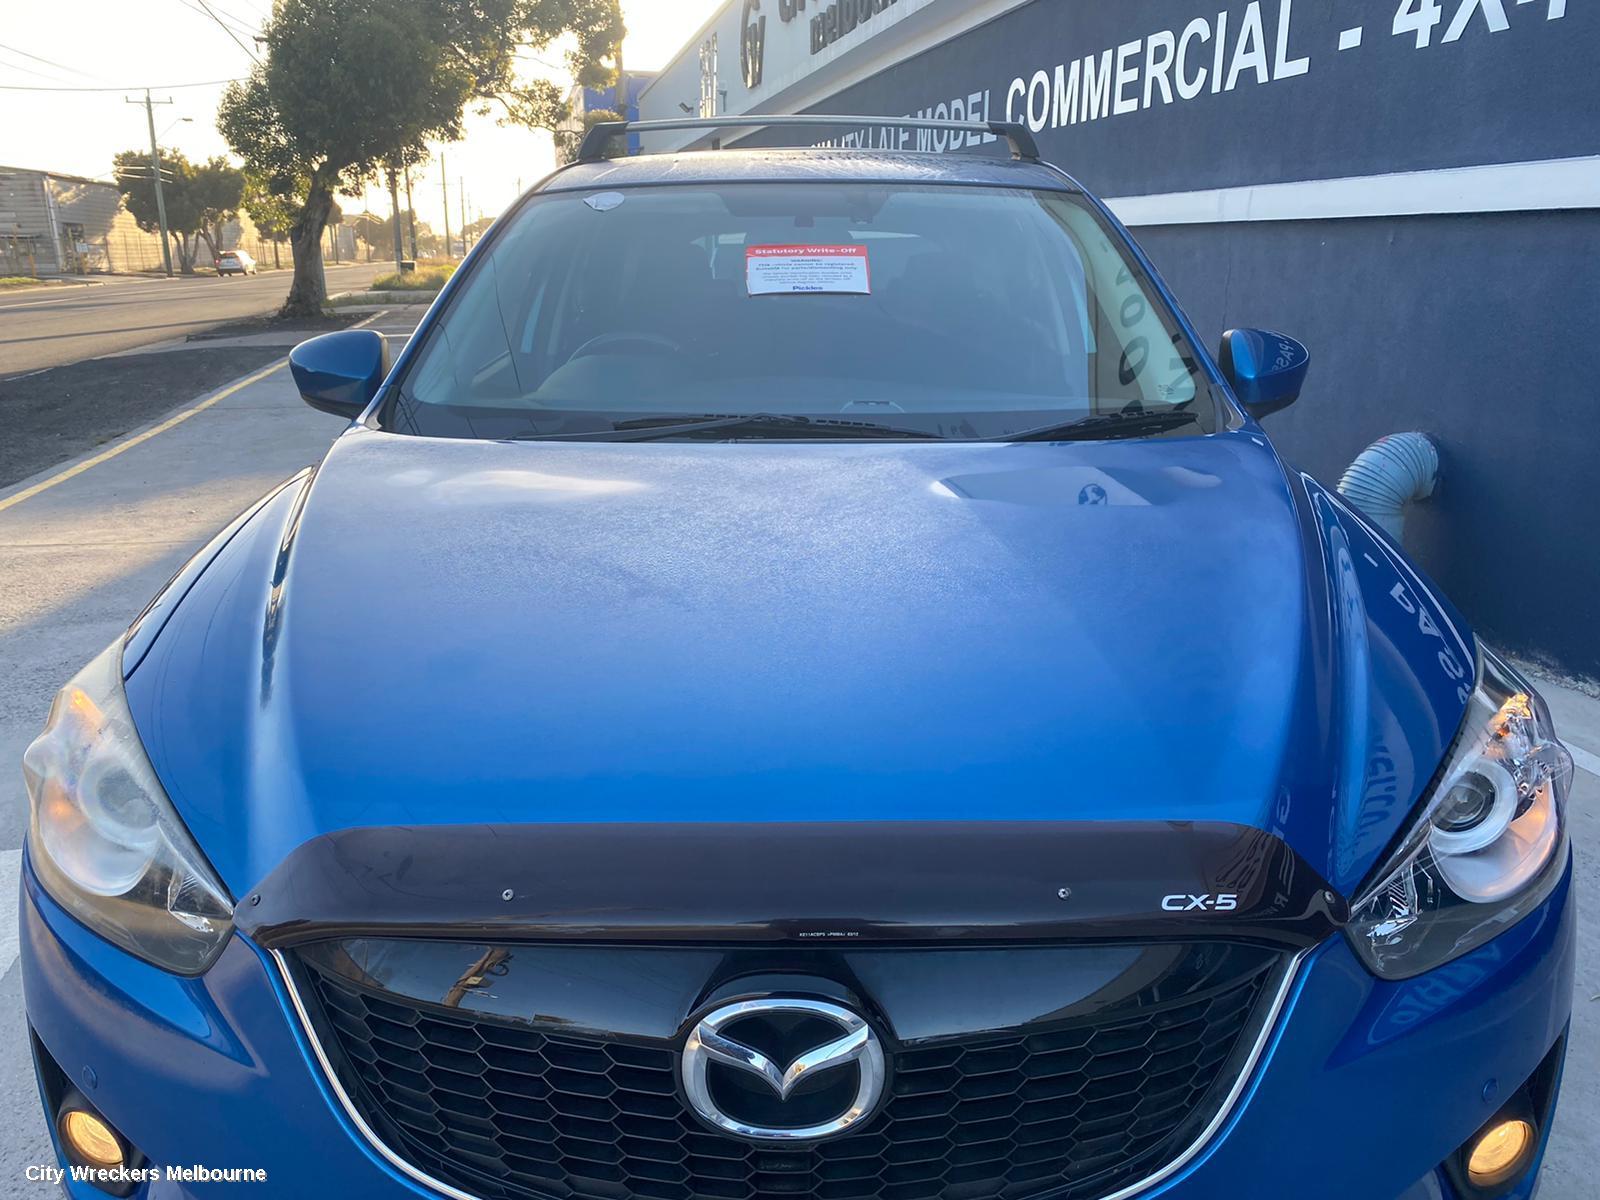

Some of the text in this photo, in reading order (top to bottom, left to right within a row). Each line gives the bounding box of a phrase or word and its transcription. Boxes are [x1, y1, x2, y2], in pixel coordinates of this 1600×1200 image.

[1005, 0, 1310, 134] COMMERCIAL
[755, 247, 804, 255] Statutory
[1161, 894, 1237, 911] CX-5
